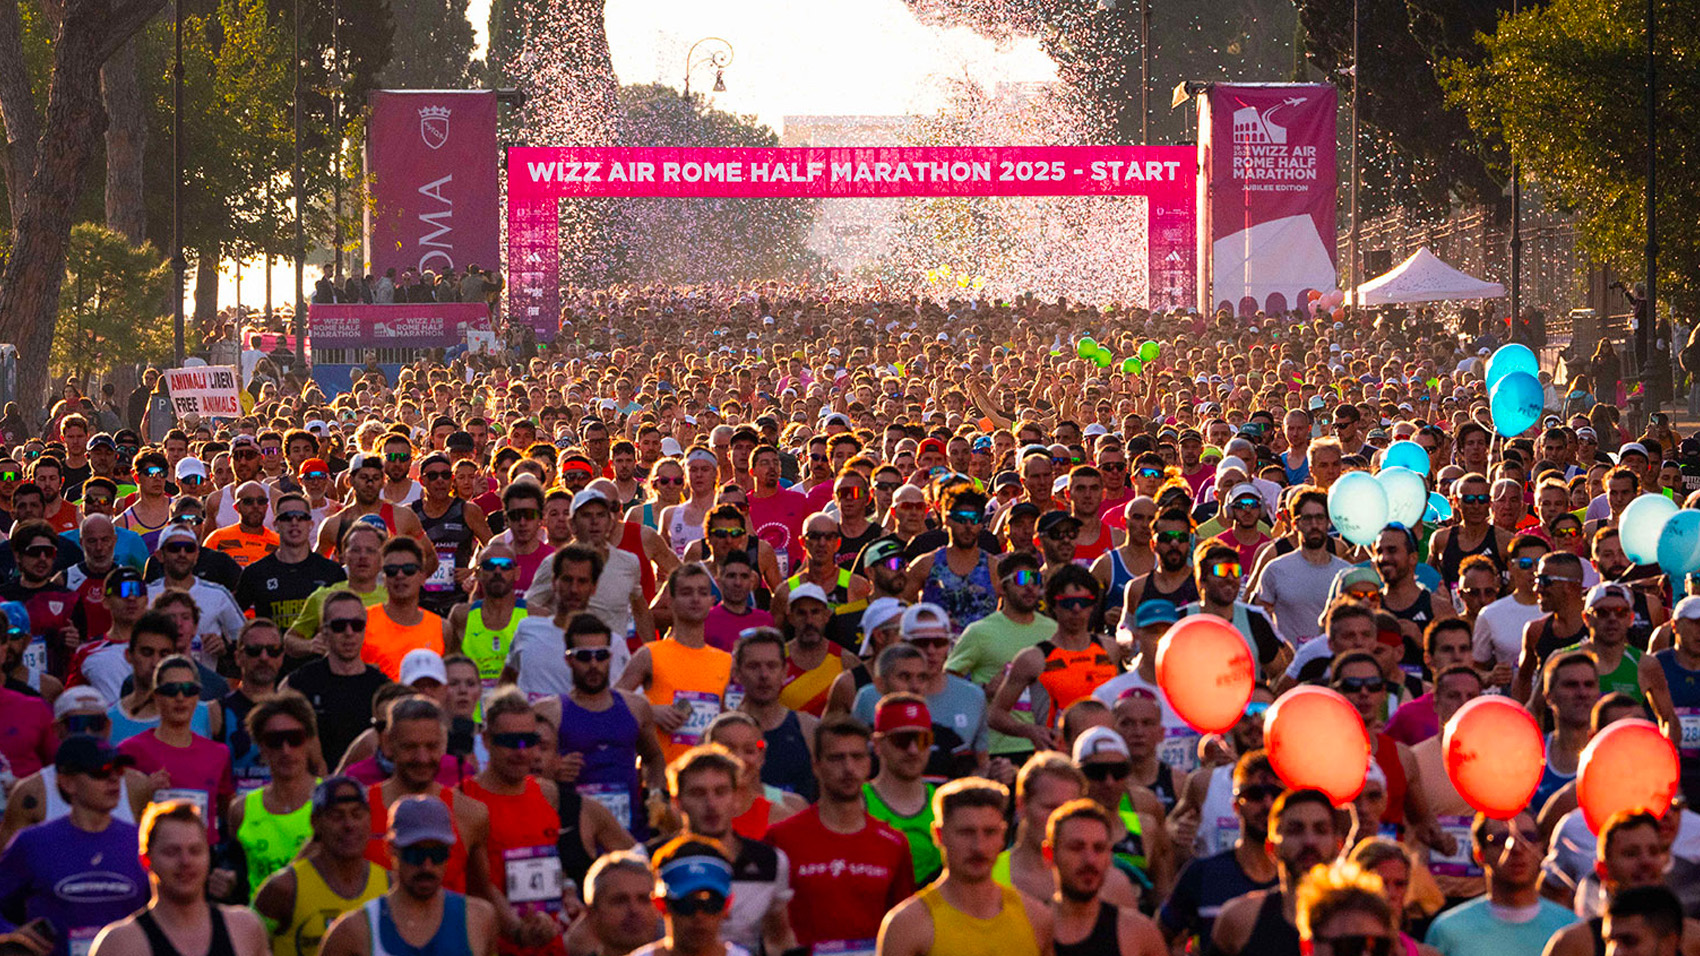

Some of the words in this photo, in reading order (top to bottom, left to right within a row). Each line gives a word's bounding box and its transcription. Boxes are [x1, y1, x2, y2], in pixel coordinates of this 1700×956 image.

[1252, 146, 1288, 156] WIZZ
[1292, 146, 1316, 156] AIR
[1233, 157, 1275, 168] ROME
[1278, 157, 1316, 168] HALF
[527, 162, 601, 182] WIZZ
[608, 162, 656, 182] AIR
[663, 162, 742, 182] ROME
[751, 162, 823, 182] HALF
[830, 161, 991, 182] MARATHON
[999, 161, 1066, 182] 2025
[1090, 160, 1181, 181] START
[1233, 169, 1317, 180] MARATHON
[1275, 184, 1308, 192] EDITION
[418, 174, 453, 276] OMA
[170, 372, 207, 391] ANIMALI
[175, 396, 199, 412] FREE
[202, 396, 237, 413] ANIMALS
